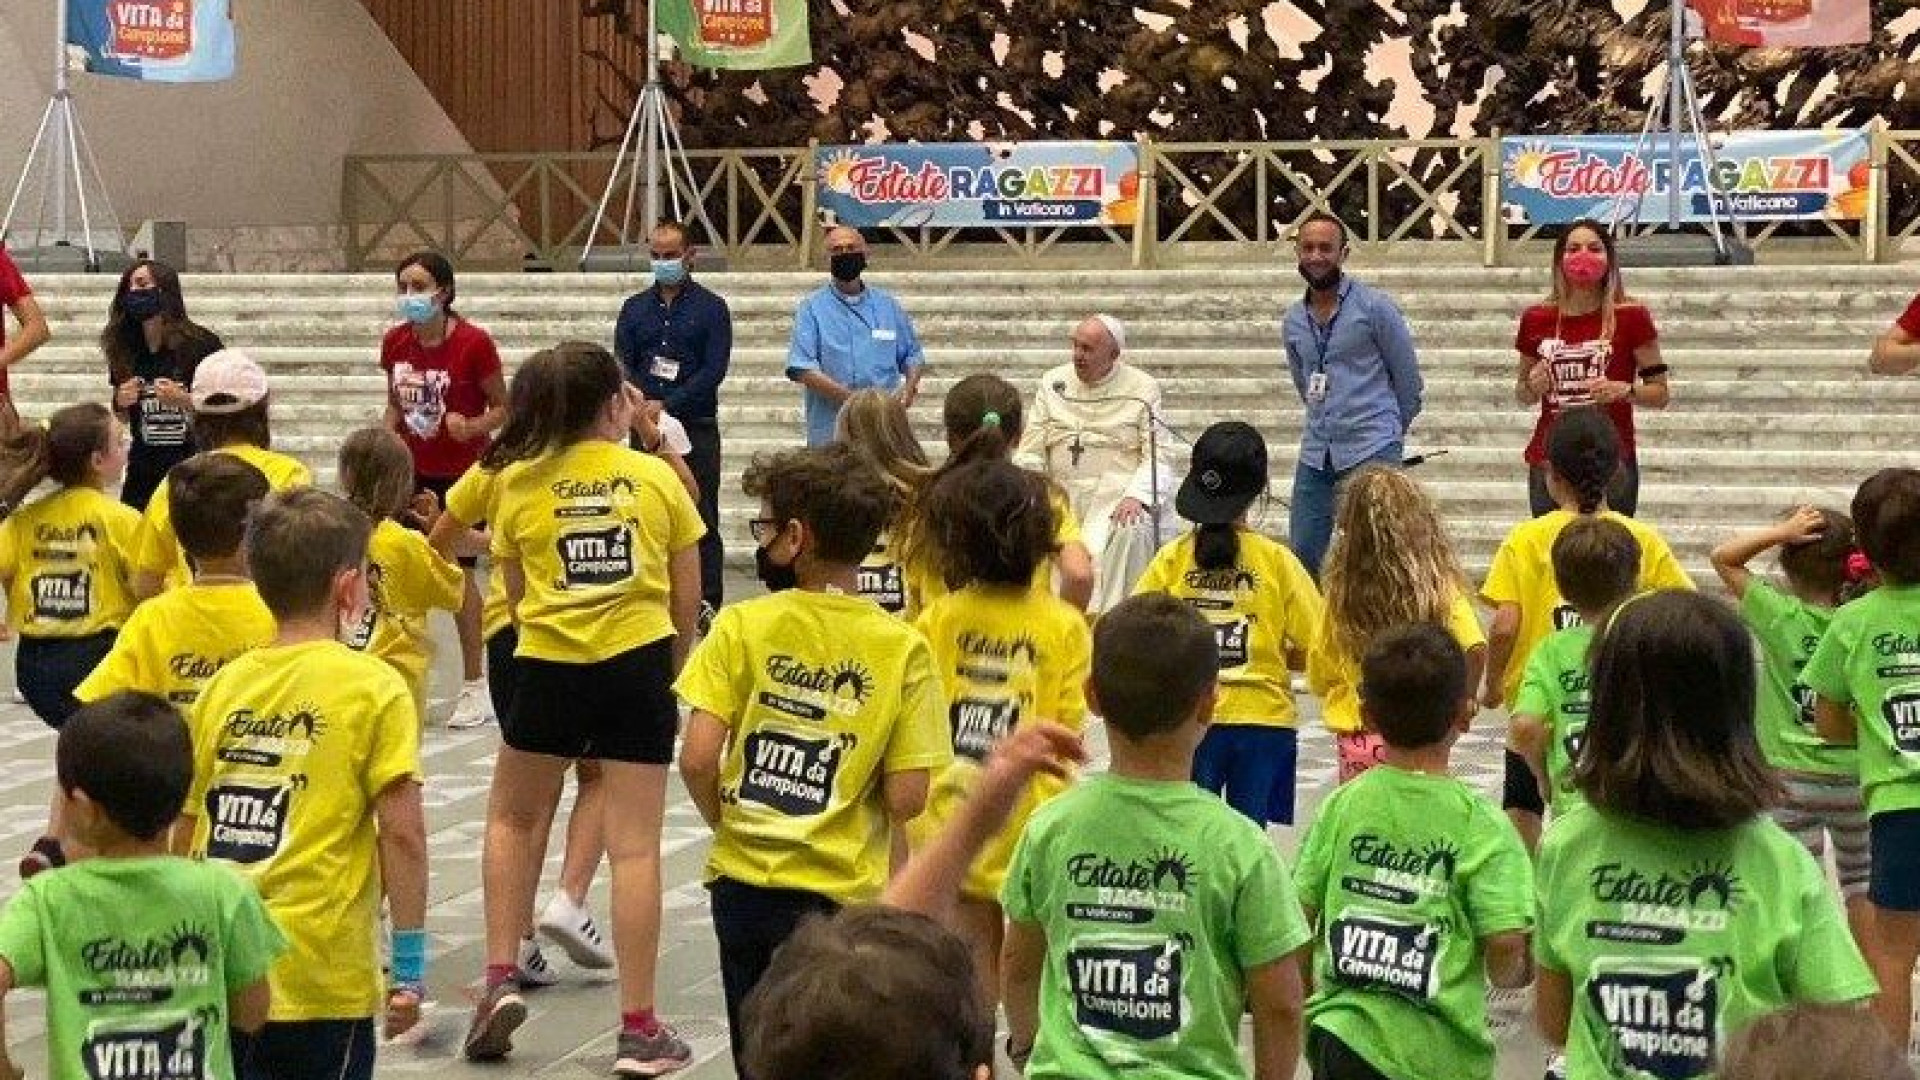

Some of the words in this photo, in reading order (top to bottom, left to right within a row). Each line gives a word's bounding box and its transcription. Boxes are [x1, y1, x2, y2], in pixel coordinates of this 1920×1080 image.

[117, 3, 162, 27] VITA
[166, 12, 184, 29] da
[848, 155, 950, 202] Estate
[949, 165, 1106, 200] RAGAZZI
[1539, 150, 1652, 196] Estate
[999, 203, 1010, 216] in
[1013, 202, 1076, 216] Vaticano
[565, 537, 607, 560] VITA
[765, 655, 832, 693] Estate
[755, 739, 806, 777] VITA
[806, 762, 827, 784] da
[749, 768, 826, 803] Campione
[1066, 853, 1152, 890] Estate
[1350, 834, 1424, 877] Estate
[1590, 862, 1687, 907] Estate
[1341, 925, 1399, 965] VITA
[1401, 947, 1425, 970] da
[1076, 958, 1138, 995] VITA
[1143, 972, 1170, 997] da
[1338, 956, 1423, 990] Campione
[1600, 984, 1670, 1027] VITA
[1676, 1002, 1705, 1031] da
[94, 1039, 160, 1077] VITA
[167, 1049, 194, 1075] da
